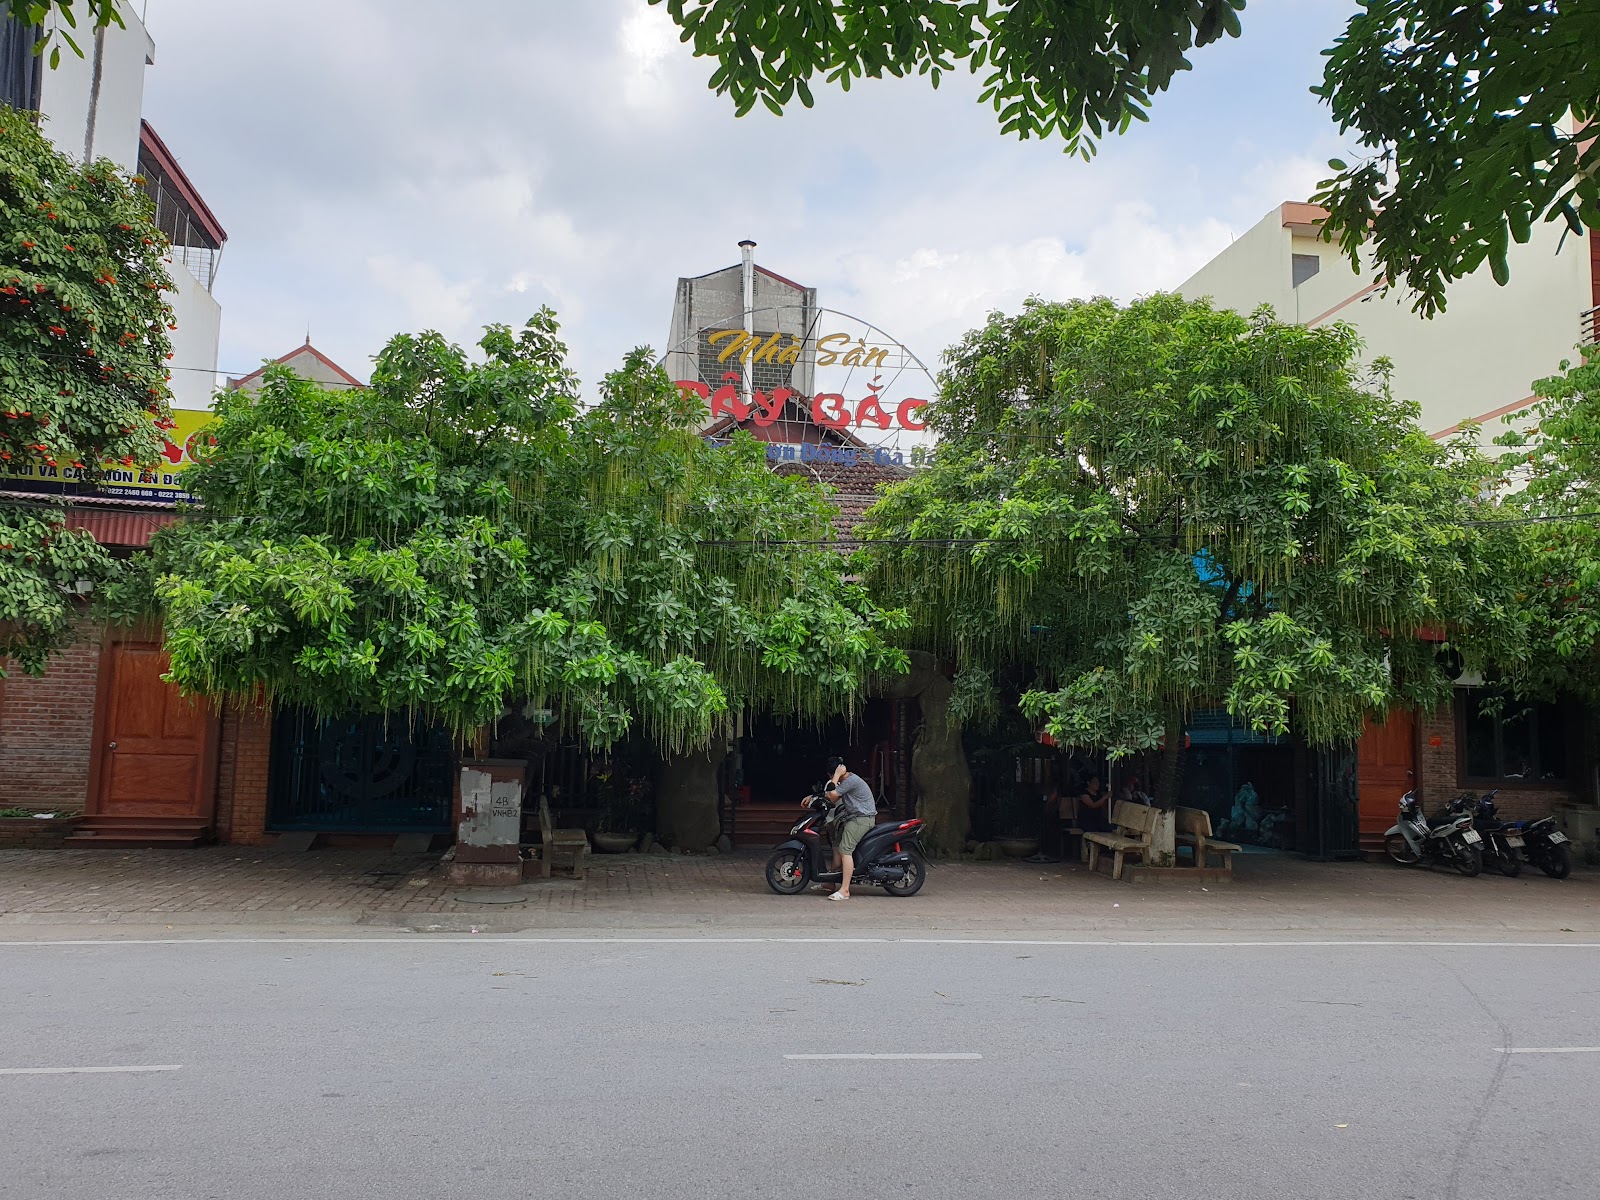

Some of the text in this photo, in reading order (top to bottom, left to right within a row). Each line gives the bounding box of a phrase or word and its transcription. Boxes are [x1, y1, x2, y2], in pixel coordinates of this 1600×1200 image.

[708, 329, 889, 368] Nhà Sàn
[495, 796, 509, 806] 4B
